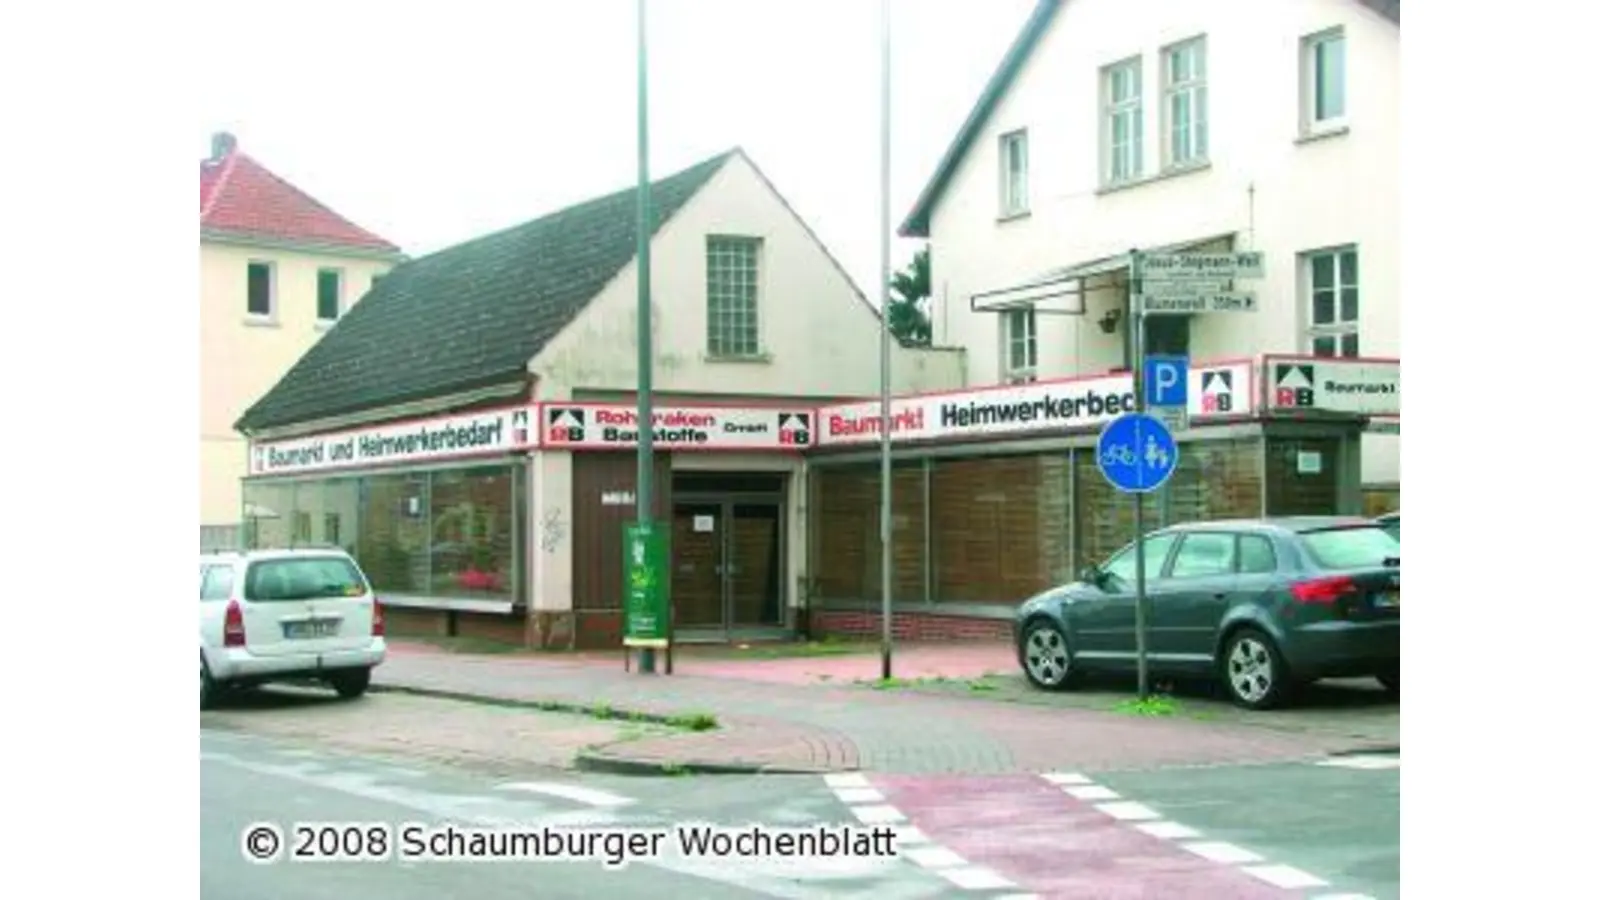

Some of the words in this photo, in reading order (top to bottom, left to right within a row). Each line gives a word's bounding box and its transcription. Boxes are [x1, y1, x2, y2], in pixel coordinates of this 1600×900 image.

[1155, 363, 1178, 403] P
[1277, 387, 1313, 406] RB
[595, 410, 716, 427] Rohraken
[330, 437, 353, 460] und
[358, 416, 502, 457] Heimwerkerbedarf
